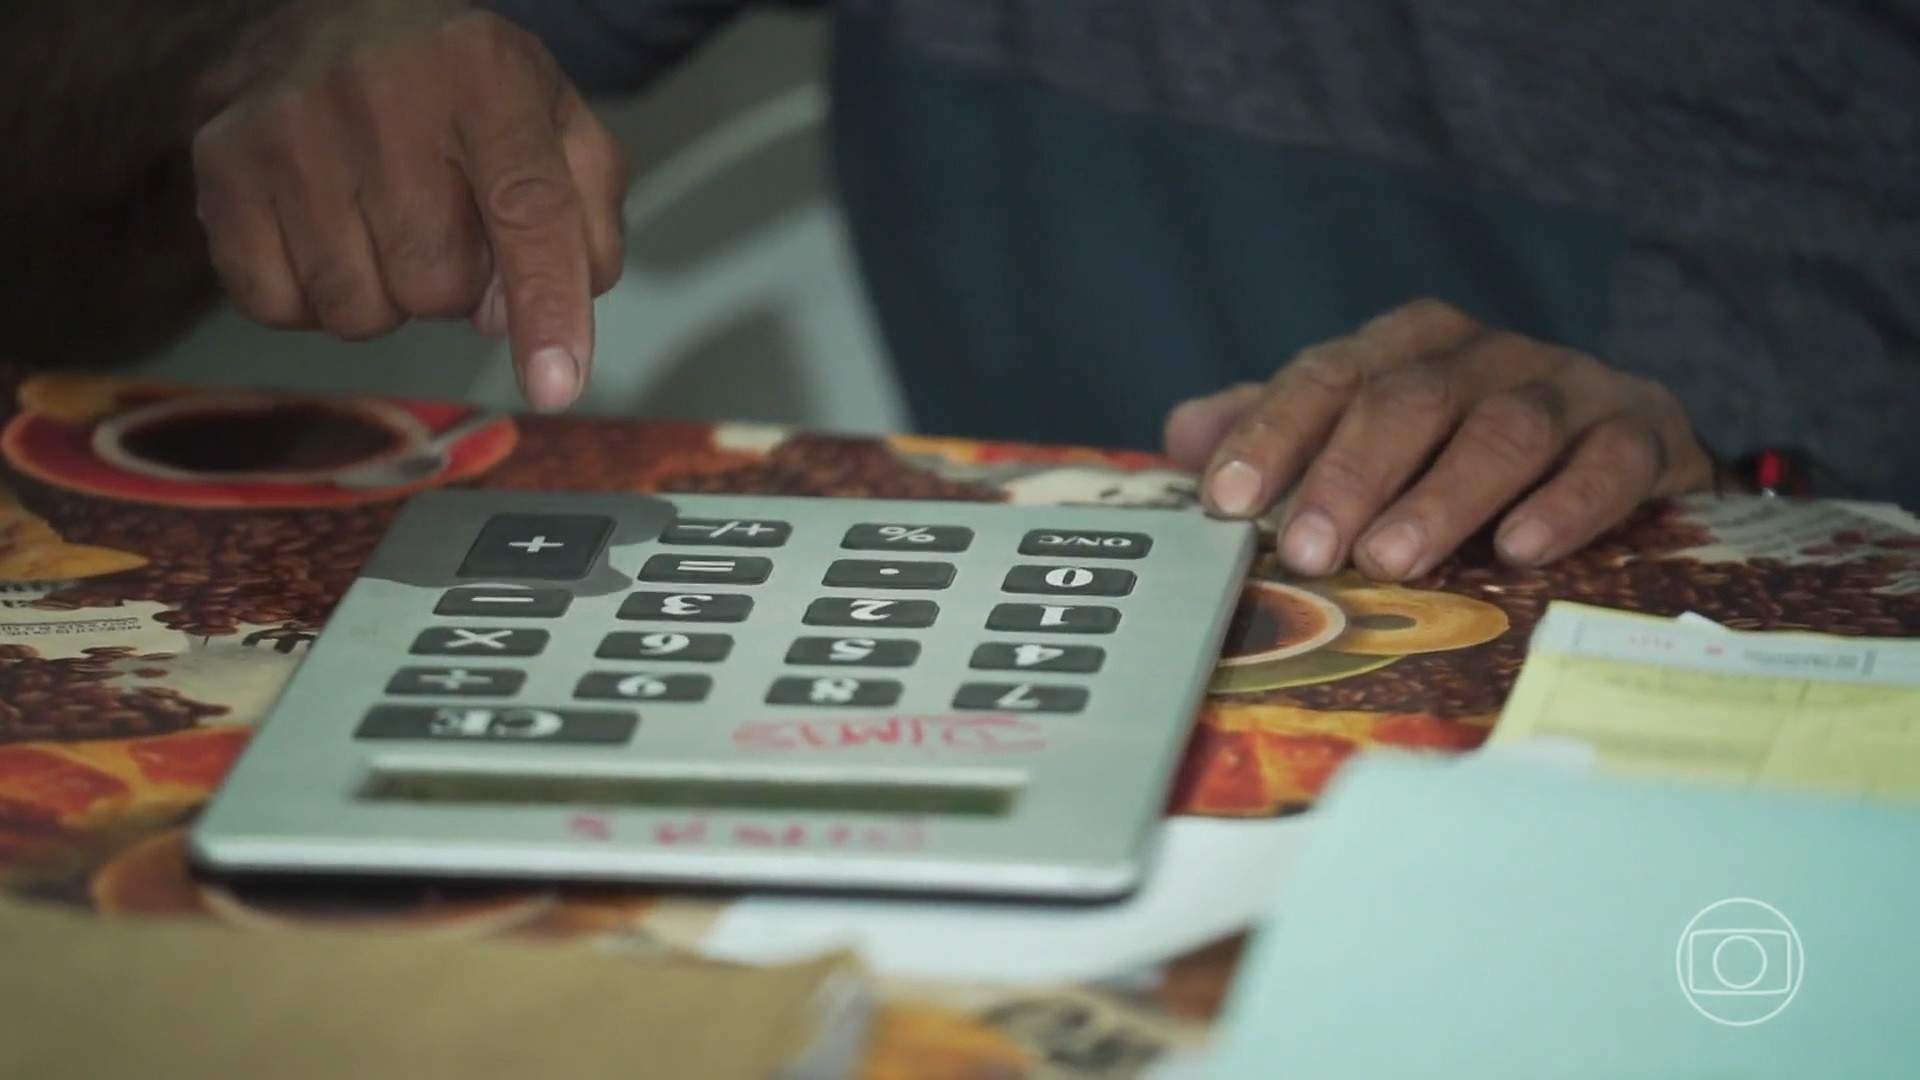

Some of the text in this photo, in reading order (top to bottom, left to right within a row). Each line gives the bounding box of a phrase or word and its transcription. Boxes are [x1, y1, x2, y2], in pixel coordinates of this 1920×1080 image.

[1038, 535, 1132, 548] ON/C
[1045, 567, 1094, 588] 0
[661, 594, 713, 615] 3
[850, 600, 898, 621] 2
[1039, 605, 1075, 627] 1
[640, 633, 690, 655] 6
[828, 639, 876, 661] 5
[1014, 644, 1064, 666] 4
[616, 675, 667, 697] 9
[809, 677, 860, 702] 8
[995, 683, 1040, 708] 7
[428, 708, 563, 738] CE
